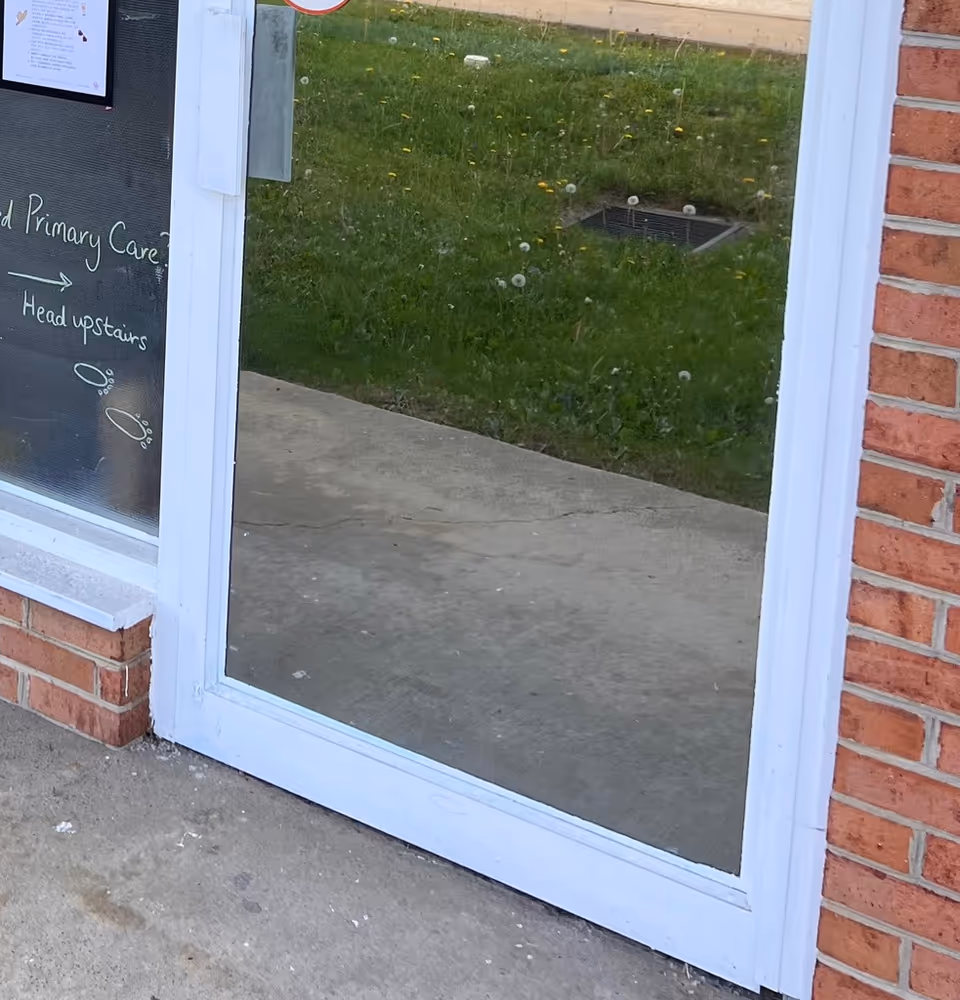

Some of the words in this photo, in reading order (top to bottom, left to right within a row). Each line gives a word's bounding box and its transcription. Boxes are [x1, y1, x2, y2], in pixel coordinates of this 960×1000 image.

[25, 193, 101, 272] Primary
[22, 290, 67, 327] Head
[73, 315, 147, 351] upstairs
